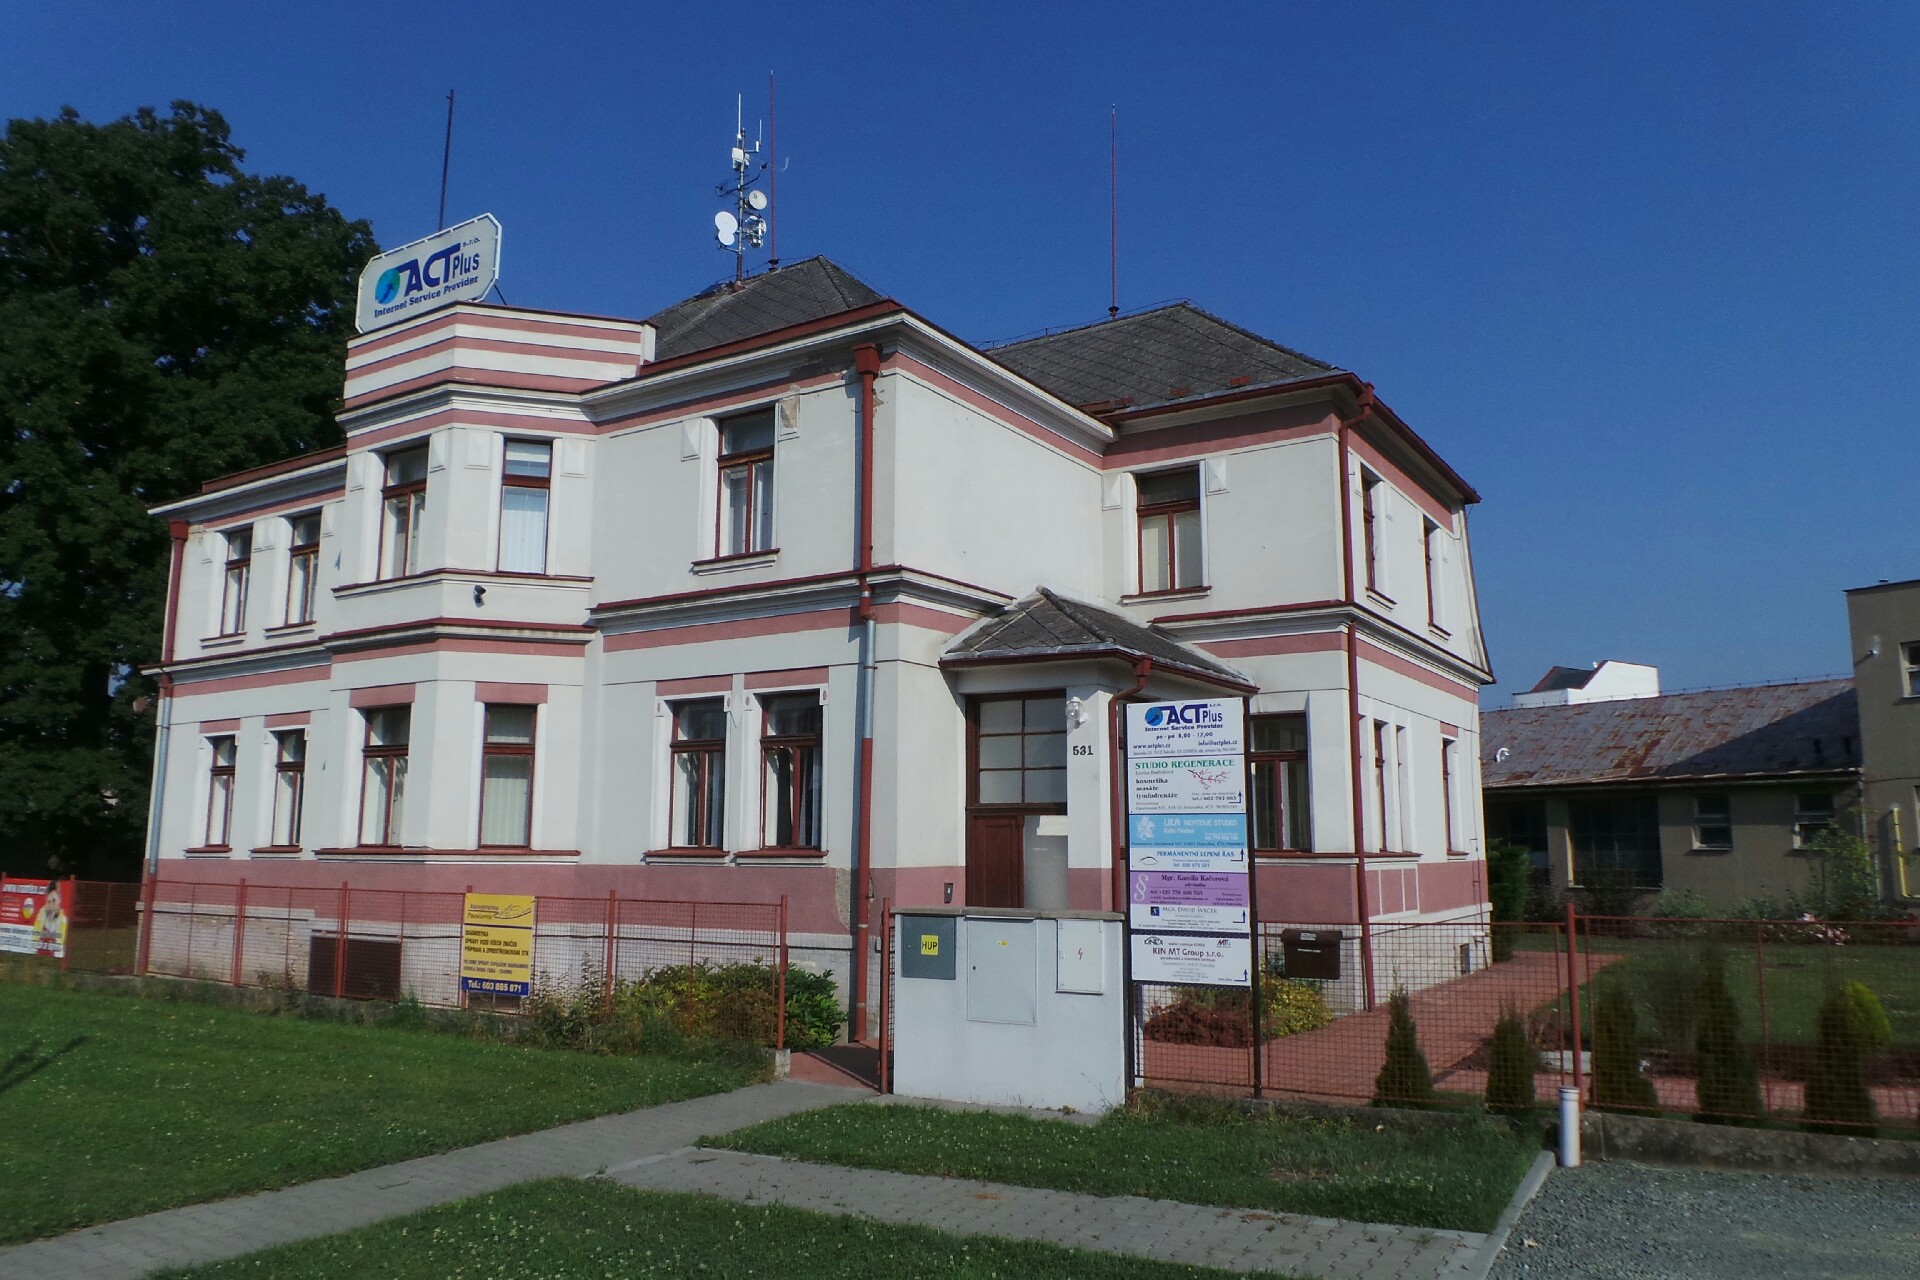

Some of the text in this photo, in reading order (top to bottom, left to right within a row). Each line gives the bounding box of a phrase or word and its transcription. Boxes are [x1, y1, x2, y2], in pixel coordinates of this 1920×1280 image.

[394, 242, 480, 297] ACT Plus
[374, 276, 478, 318] Internet Service Provider
[1160, 704, 1222, 725] ACT Plus
[1073, 745, 1093, 755] 531
[1171, 760, 1234, 768] REGENERACE
[922, 941, 938, 950] HUP
[1182, 949, 1204, 957] Group
